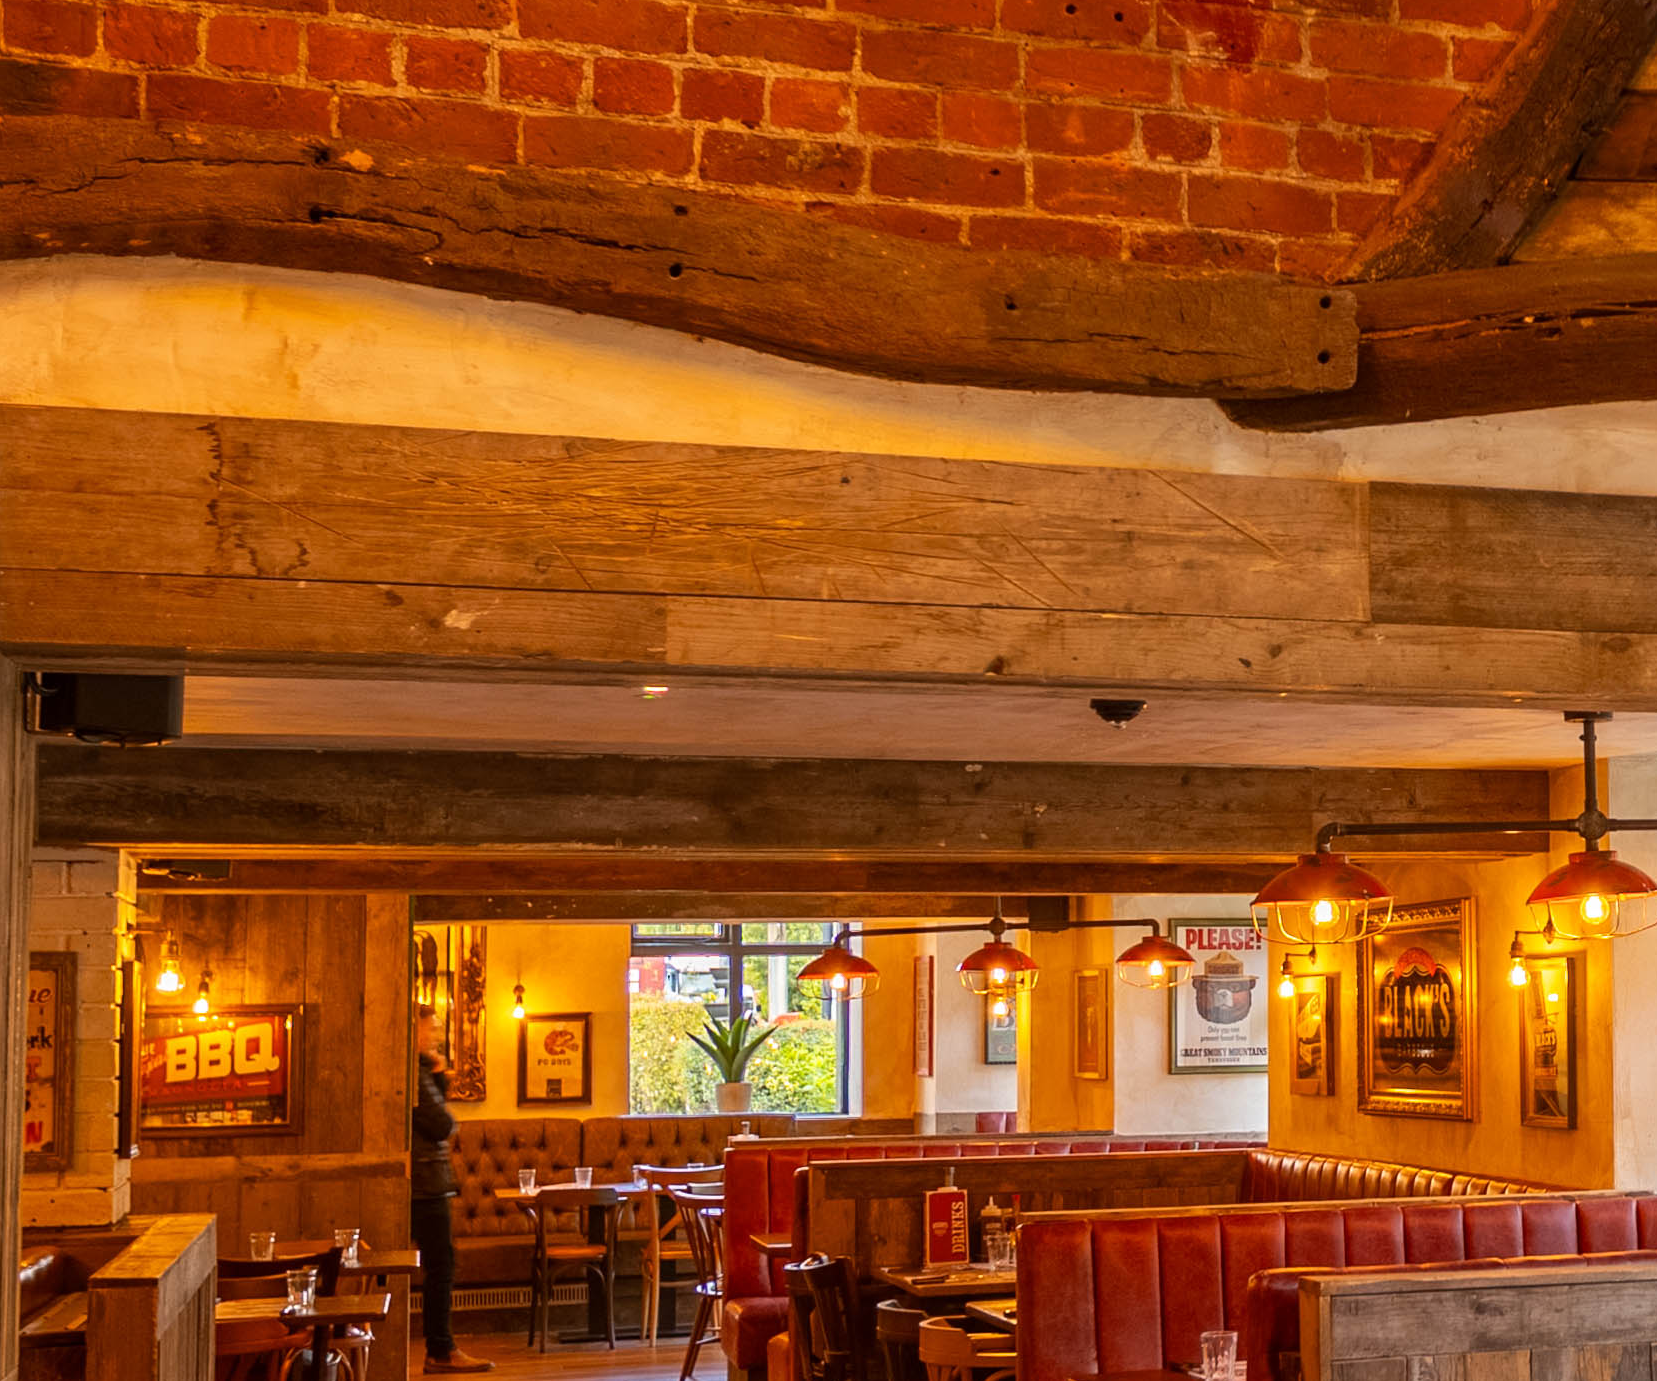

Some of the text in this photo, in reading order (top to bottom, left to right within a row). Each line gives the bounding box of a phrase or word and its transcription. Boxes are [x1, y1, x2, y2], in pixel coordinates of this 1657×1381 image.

[1185, 928, 1262, 950] PLEASE!
[1384, 983, 1450, 1038] BLACK'S
[165, 1022, 281, 1083] BBQ
[1228, 1047, 1267, 1057] MOUNTAINS
[951, 1201, 965, 1253] DRINKS
